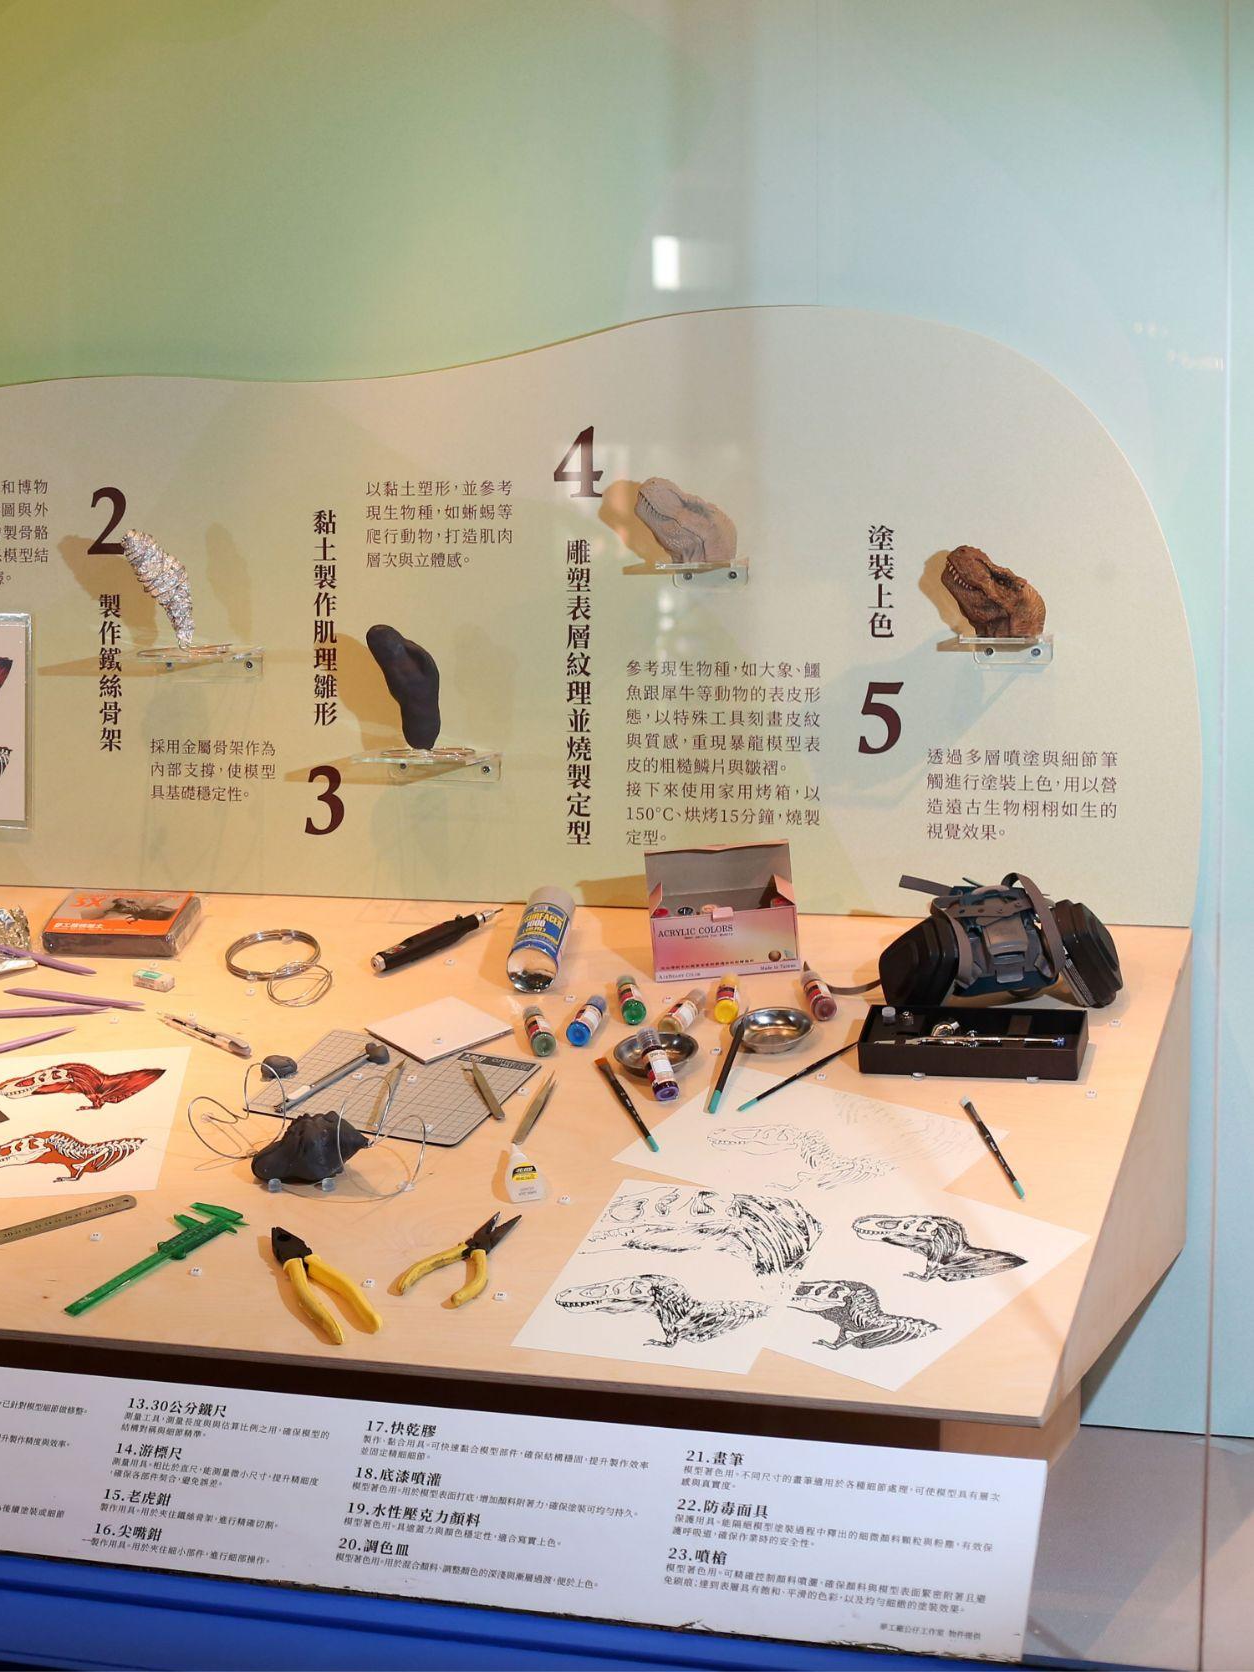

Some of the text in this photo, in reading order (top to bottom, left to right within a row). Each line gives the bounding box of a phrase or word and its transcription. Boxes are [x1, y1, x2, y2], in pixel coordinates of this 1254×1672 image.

[553, 426, 604, 498] 4
[87, 486, 127, 554] 2
[366, 551, 470, 568] 層次與立體感。
[868, 524, 894, 638] 塗裝上色
[313, 509, 337, 726] 黏土製作肌理雛形
[98, 594, 123, 752] 製作鐵絲骨架
[566, 539, 592, 845] 雕塑表層紋理並燒製定型
[858, 681, 903, 754] 5
[150, 738, 275, 755] 採用金屬骨架作為
[927, 748, 1119, 769] 透過多層噴塗與細節筆
[305, 765, 345, 835] 3
[927, 798, 1118, 819] 造遠古生物栩栩如生的
[626, 830, 666, 846] 定型。
[927, 823, 1006, 841] 視覺效果。
[658, 928, 696, 938] ACRYLIC
[698, 924, 734, 935] COLORS
[127, 1398, 227, 1417] 13.30公分鐵尺
[365, 1421, 437, 1437] 17.快乾膠
[116, 1443, 182, 1460] 14.游標尺
[686, 1450, 745, 1467] 21.畫筆
[103, 1489, 171, 1507] 15.老虎鉗
[346, 1502, 481, 1526] 19.水性壓克力顏料
[677, 1499, 769, 1519] 22.防毒面具
[94, 1523, 163, 1541] 16.尖嘴鉗
[338, 1537, 409, 1557] 20.調色皿
[668, 1547, 728, 1566] 23.噴槍
